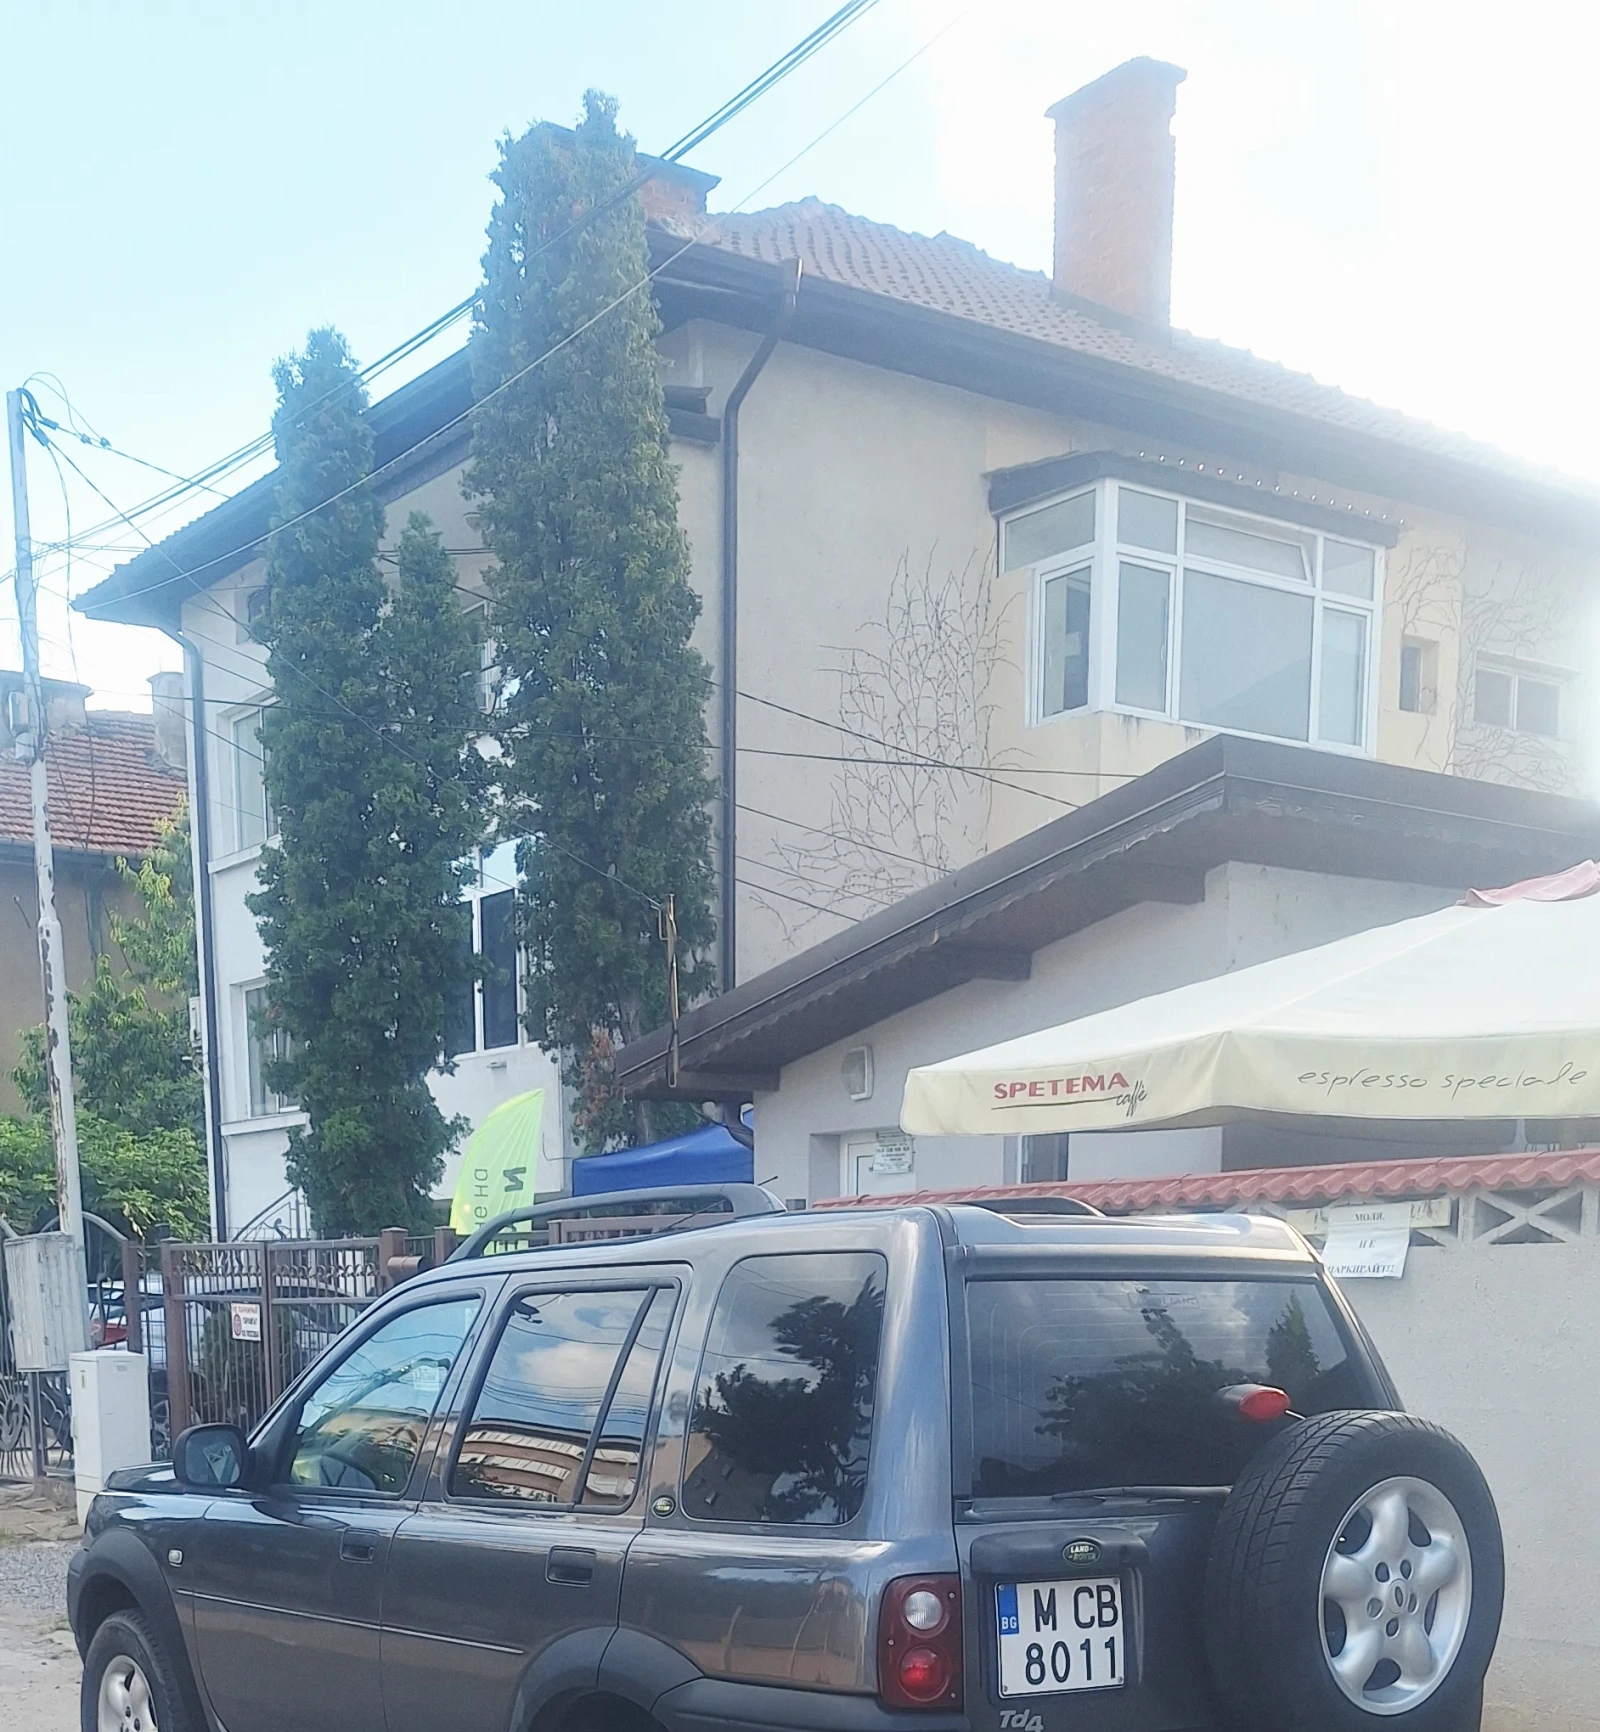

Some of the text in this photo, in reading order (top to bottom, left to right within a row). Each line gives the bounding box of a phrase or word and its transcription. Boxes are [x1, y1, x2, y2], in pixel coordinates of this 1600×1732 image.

[994, 1072, 1129, 1099] SPETEMA
[1298, 1062, 1587, 1100] espresso speciale
[1070, 1545, 1090, 1554] LAND
[1033, 1584, 1118, 1632] M CB
[1001, 1616, 1017, 1630] BG
[1025, 1636, 1116, 1685] 8011
[1000, 1709, 1044, 1732] Td4
